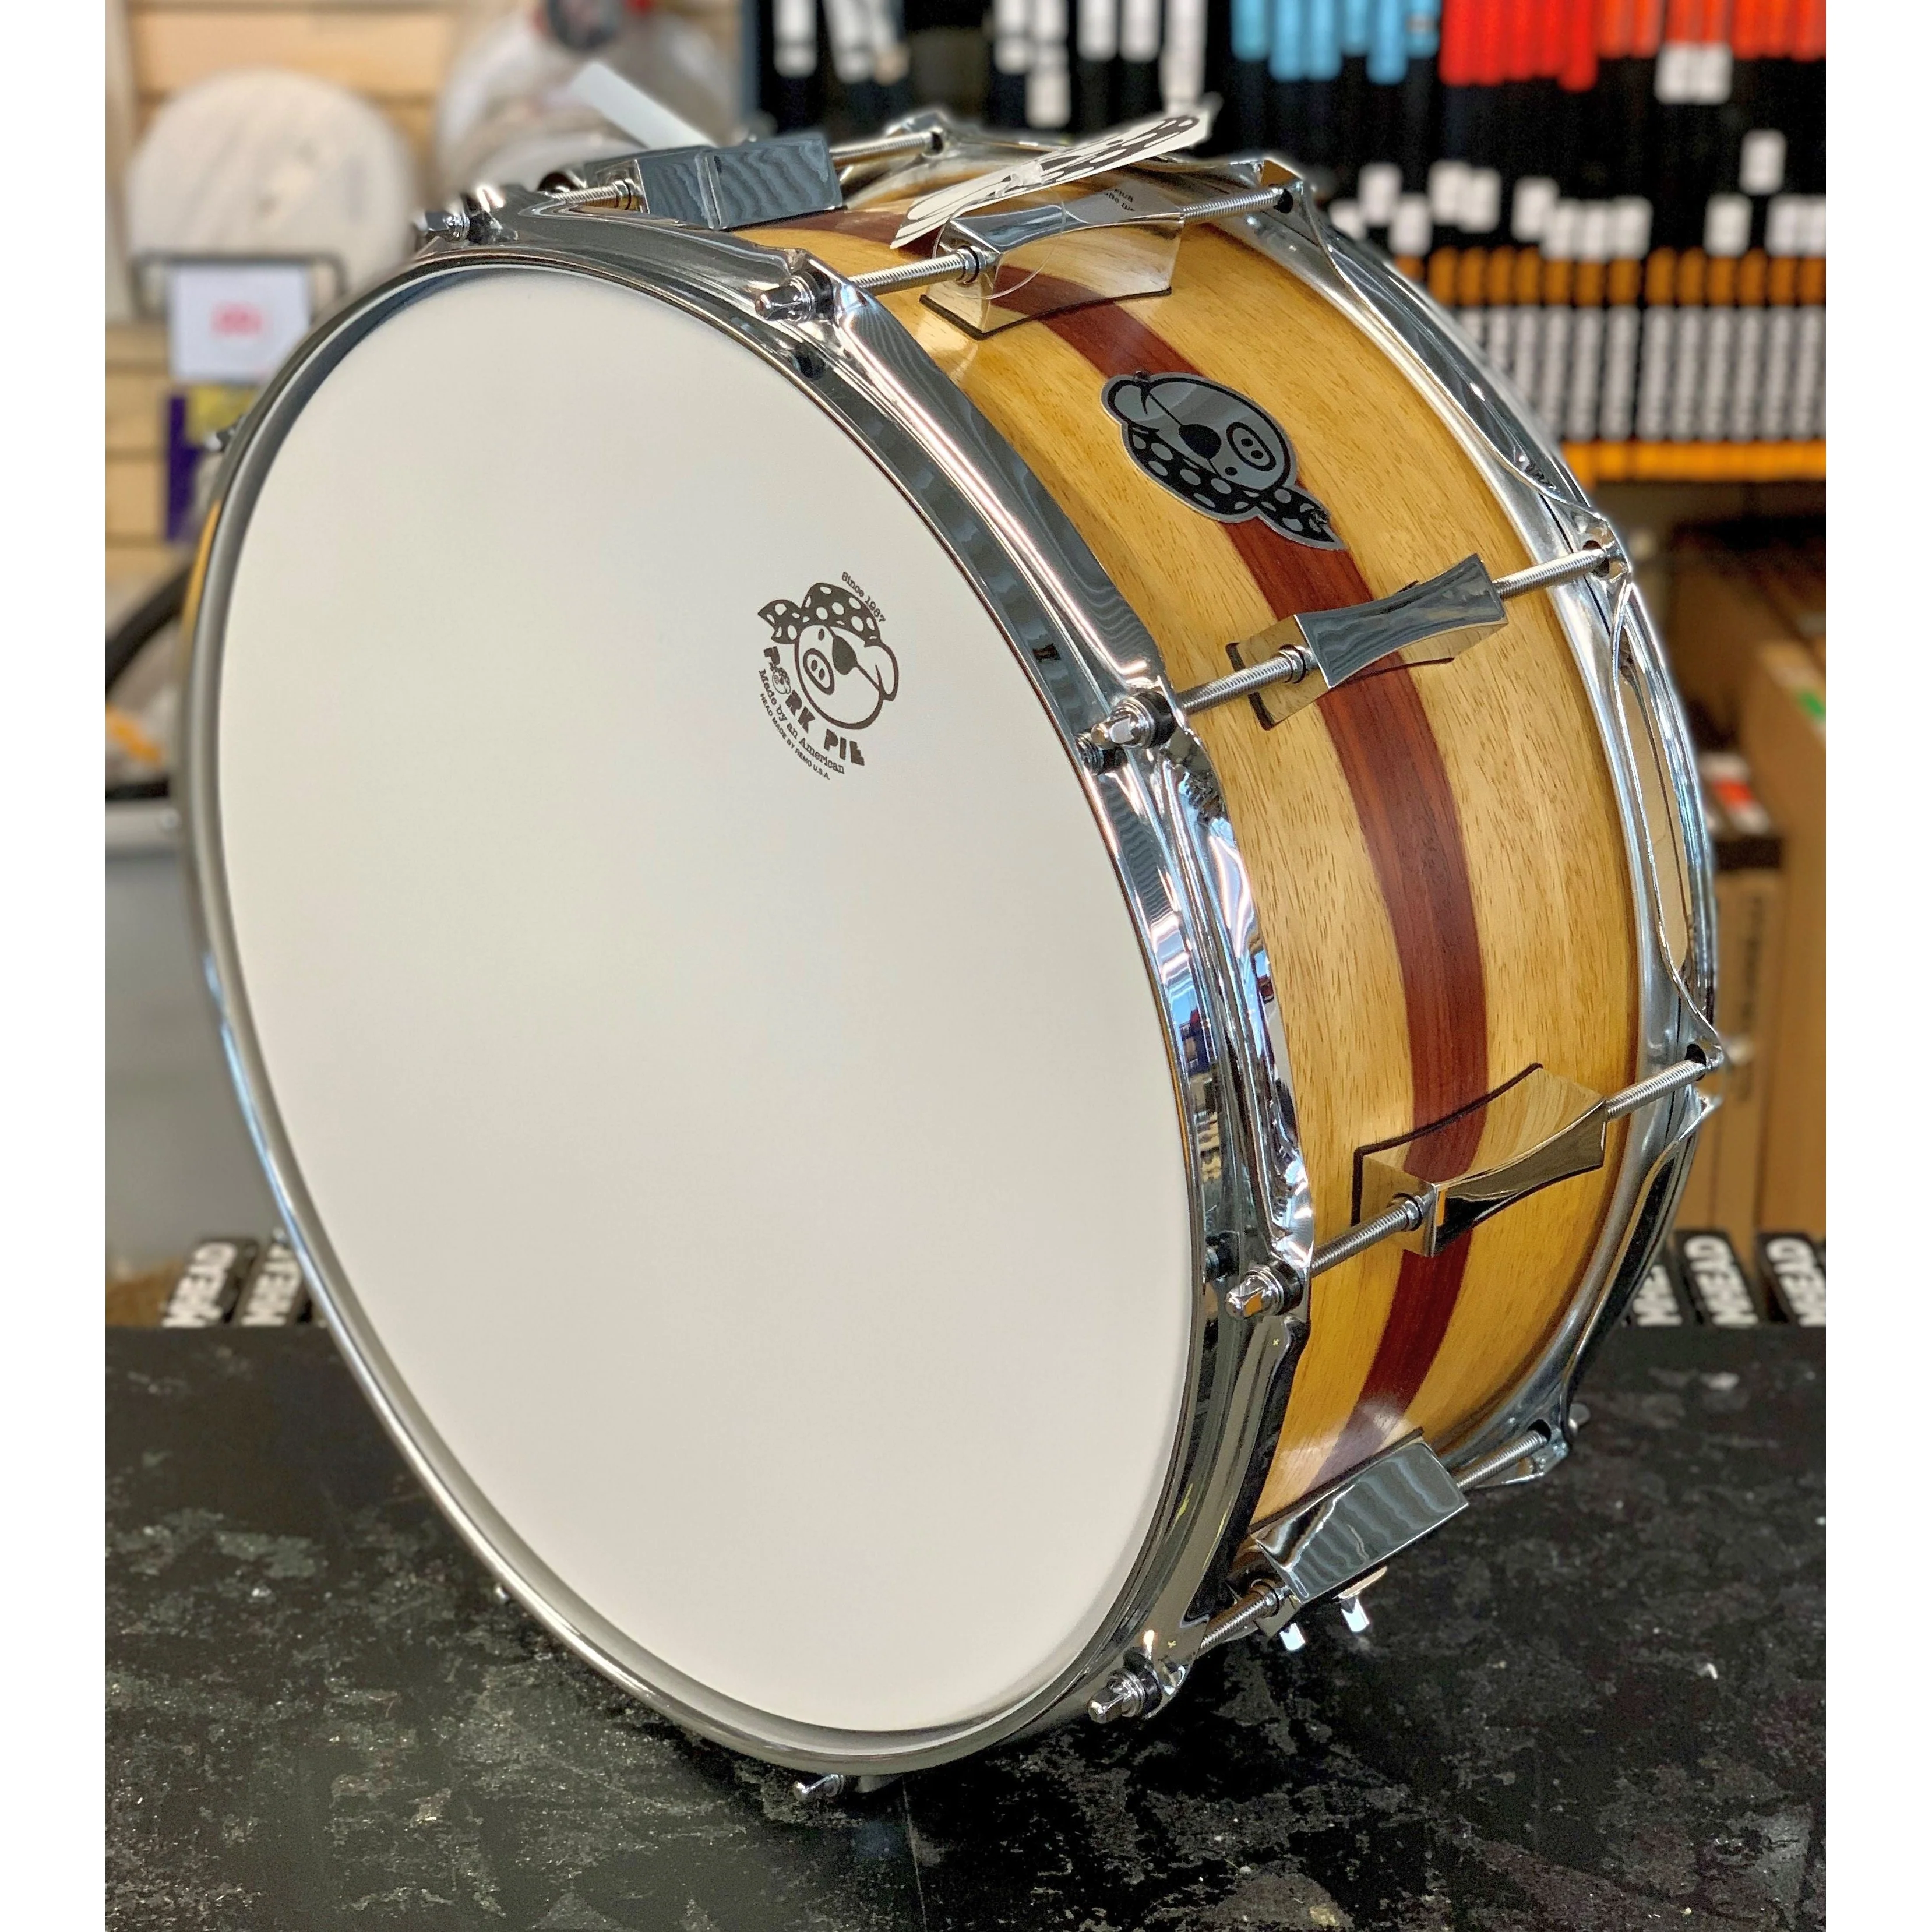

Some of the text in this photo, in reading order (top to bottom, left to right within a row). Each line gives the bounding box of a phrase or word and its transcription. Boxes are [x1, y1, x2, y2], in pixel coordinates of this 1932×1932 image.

[841, 572, 886, 622] Since 1987
[759, 668, 845, 775] Made by an American
[760, 693, 773, 717] HEAD
[772, 717, 787, 739] MADE
[787, 738, 795, 749] BY
[795, 748, 812, 767] REMO
[824, 728, 865, 766] PIE
